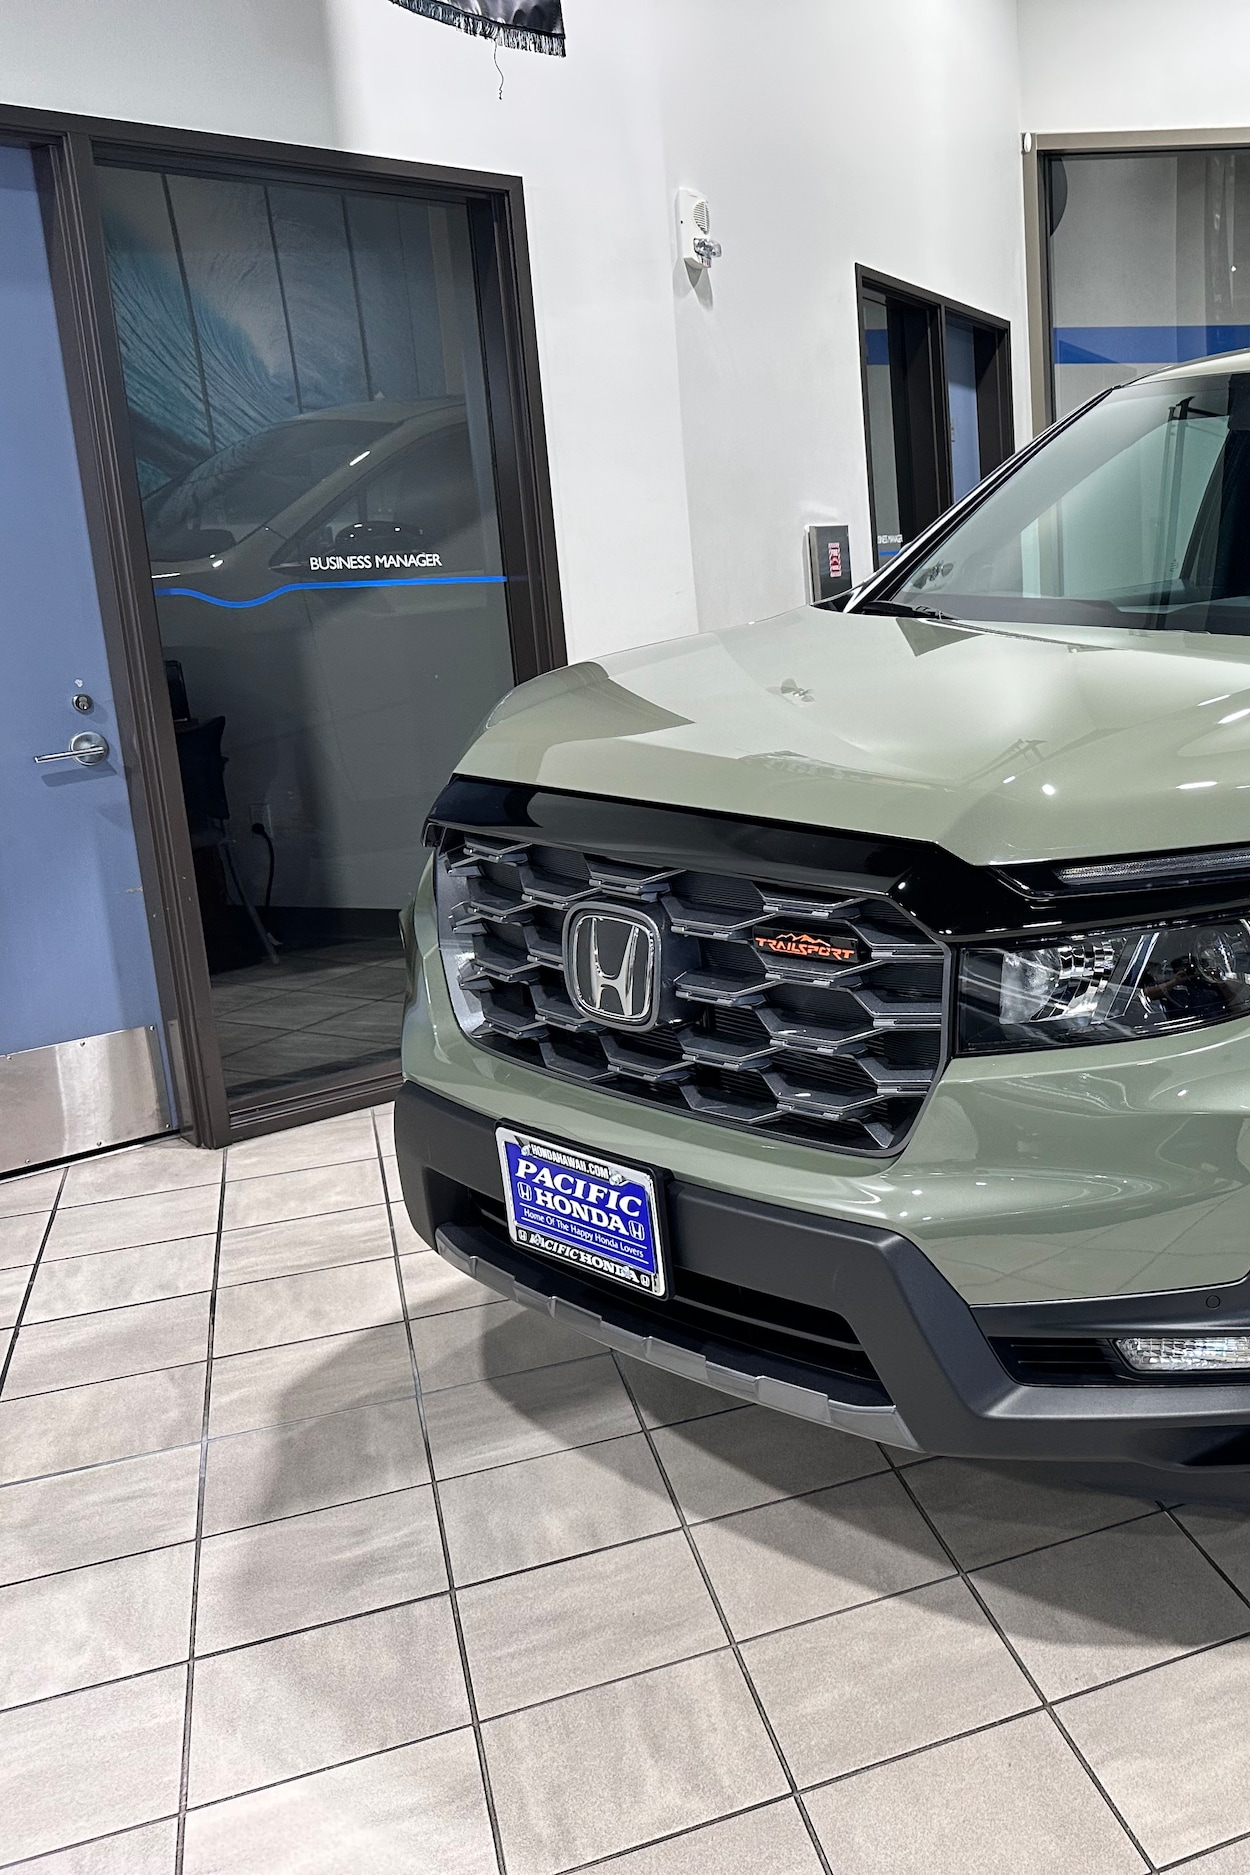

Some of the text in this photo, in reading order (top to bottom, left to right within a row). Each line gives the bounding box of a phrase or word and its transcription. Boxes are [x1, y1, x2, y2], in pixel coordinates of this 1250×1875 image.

[309, 553, 442, 570] BUSINESS MANAGER
[755, 937, 855, 960] TRAILSPORT
[530, 1143, 611, 1180] HONDAHAWAII.COM
[515, 1157, 642, 1217] PACIFIC
[524, 1207, 644, 1258] Home Of The Happy Honda Lovers
[533, 1187, 629, 1236] HONDA
